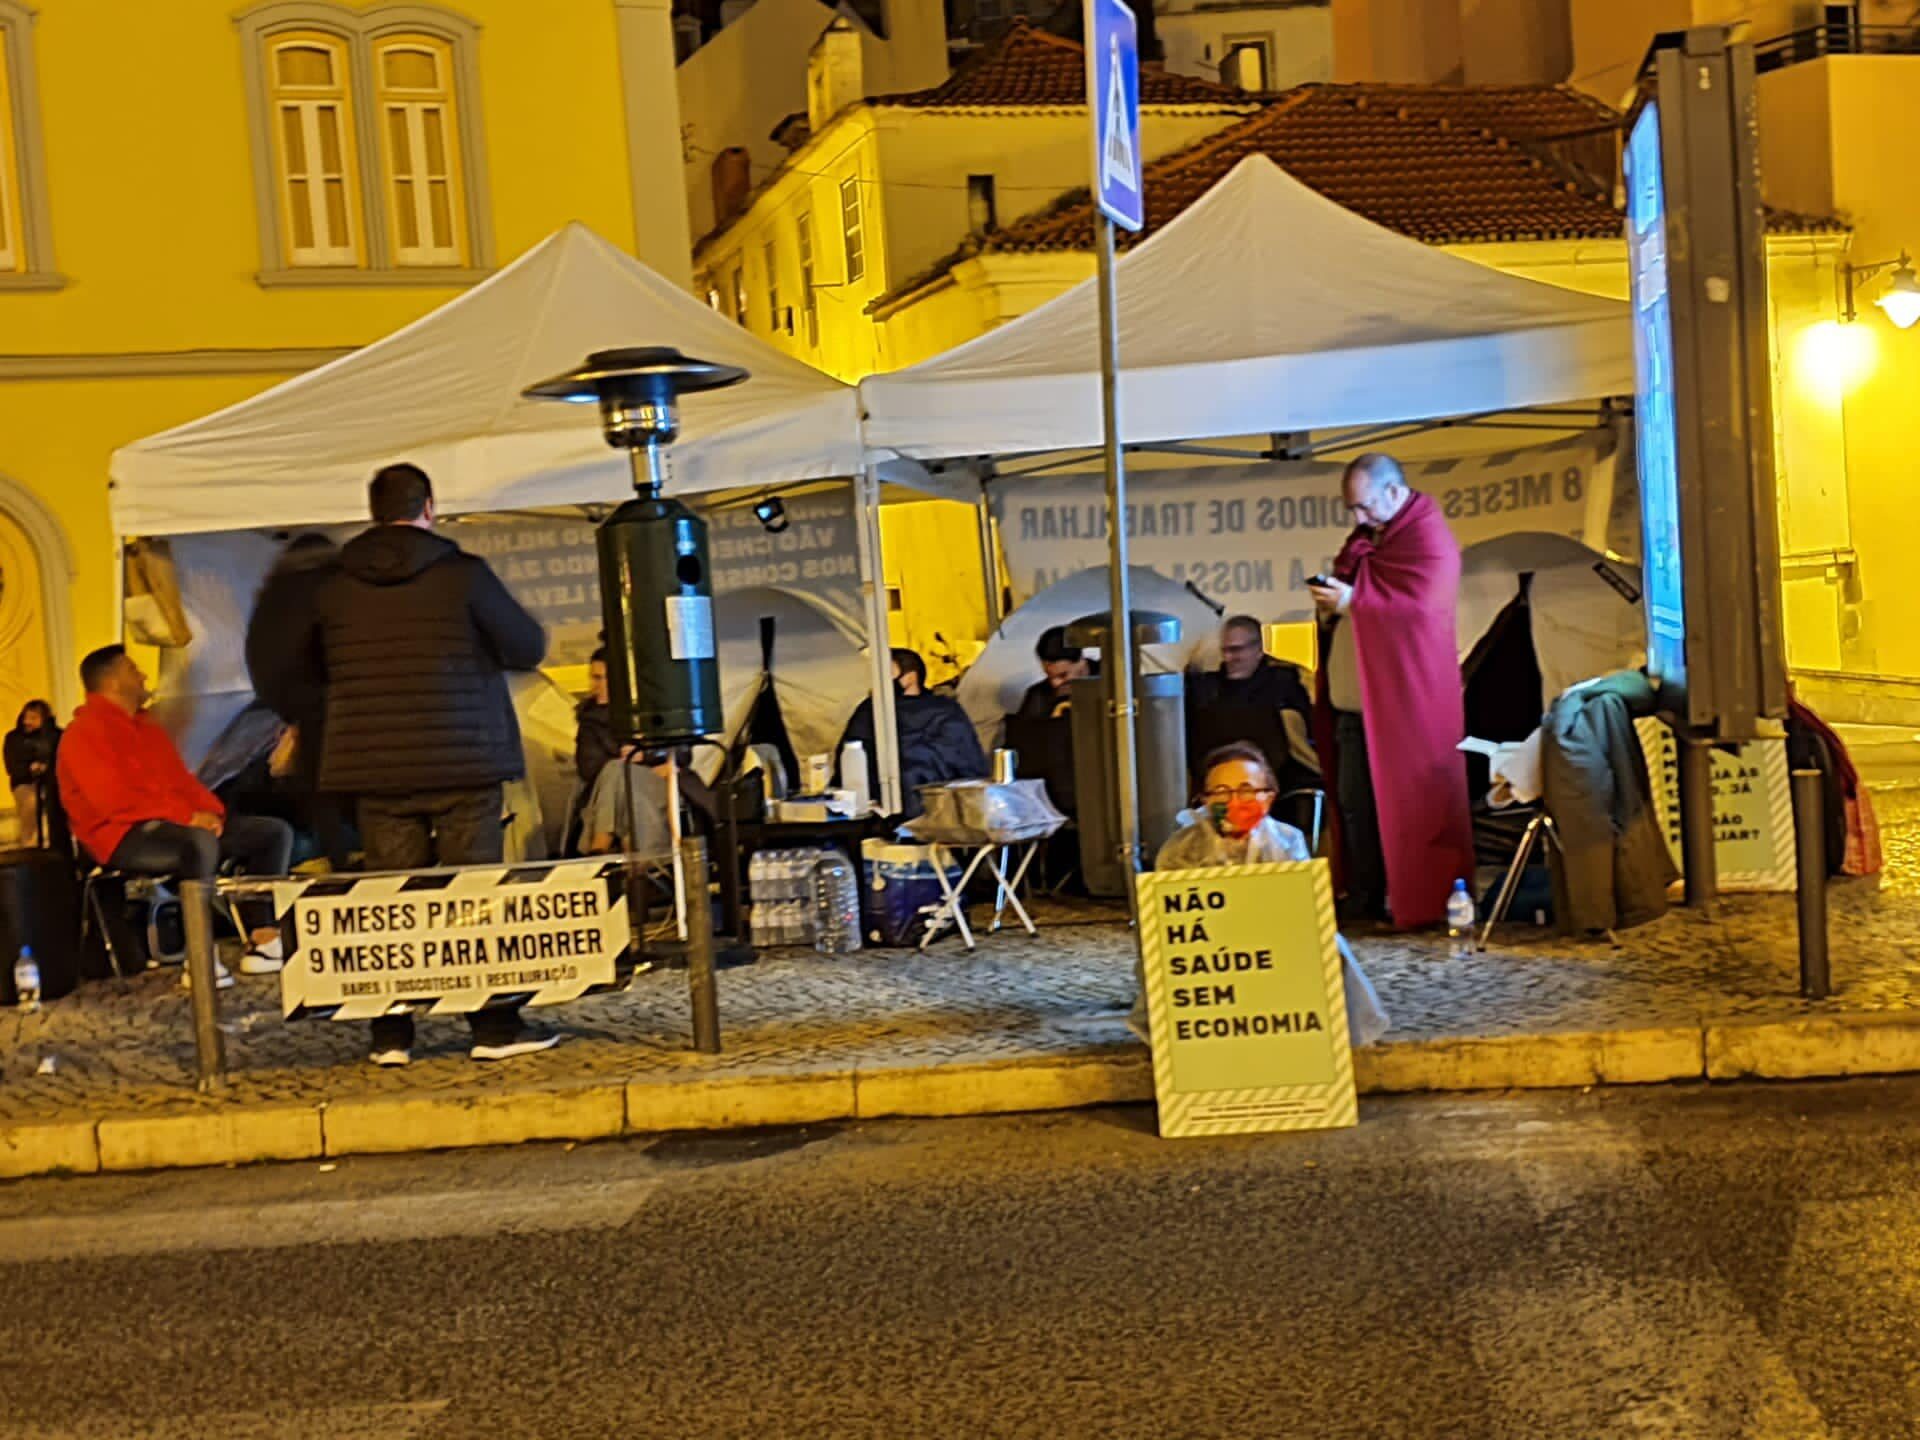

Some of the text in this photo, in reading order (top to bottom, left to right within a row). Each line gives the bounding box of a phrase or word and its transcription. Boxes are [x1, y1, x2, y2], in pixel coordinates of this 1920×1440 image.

[305, 890, 599, 935] 9 MESES PARA NASCER
[1163, 886, 1225, 914] NÃO
[1167, 916, 1209, 944] HÁ
[310, 928, 603, 974] 9 MESES PARA MORRER
[1169, 945, 1273, 976] SAÚDE
[340, 981, 382, 996] BARES
[395, 974, 471, 993] DISCOTECAS
[486, 964, 579, 987] RESTAURAÇÃO
[1172, 983, 1236, 1008] SEM
[1176, 1010, 1323, 1041] ECONOMIA
